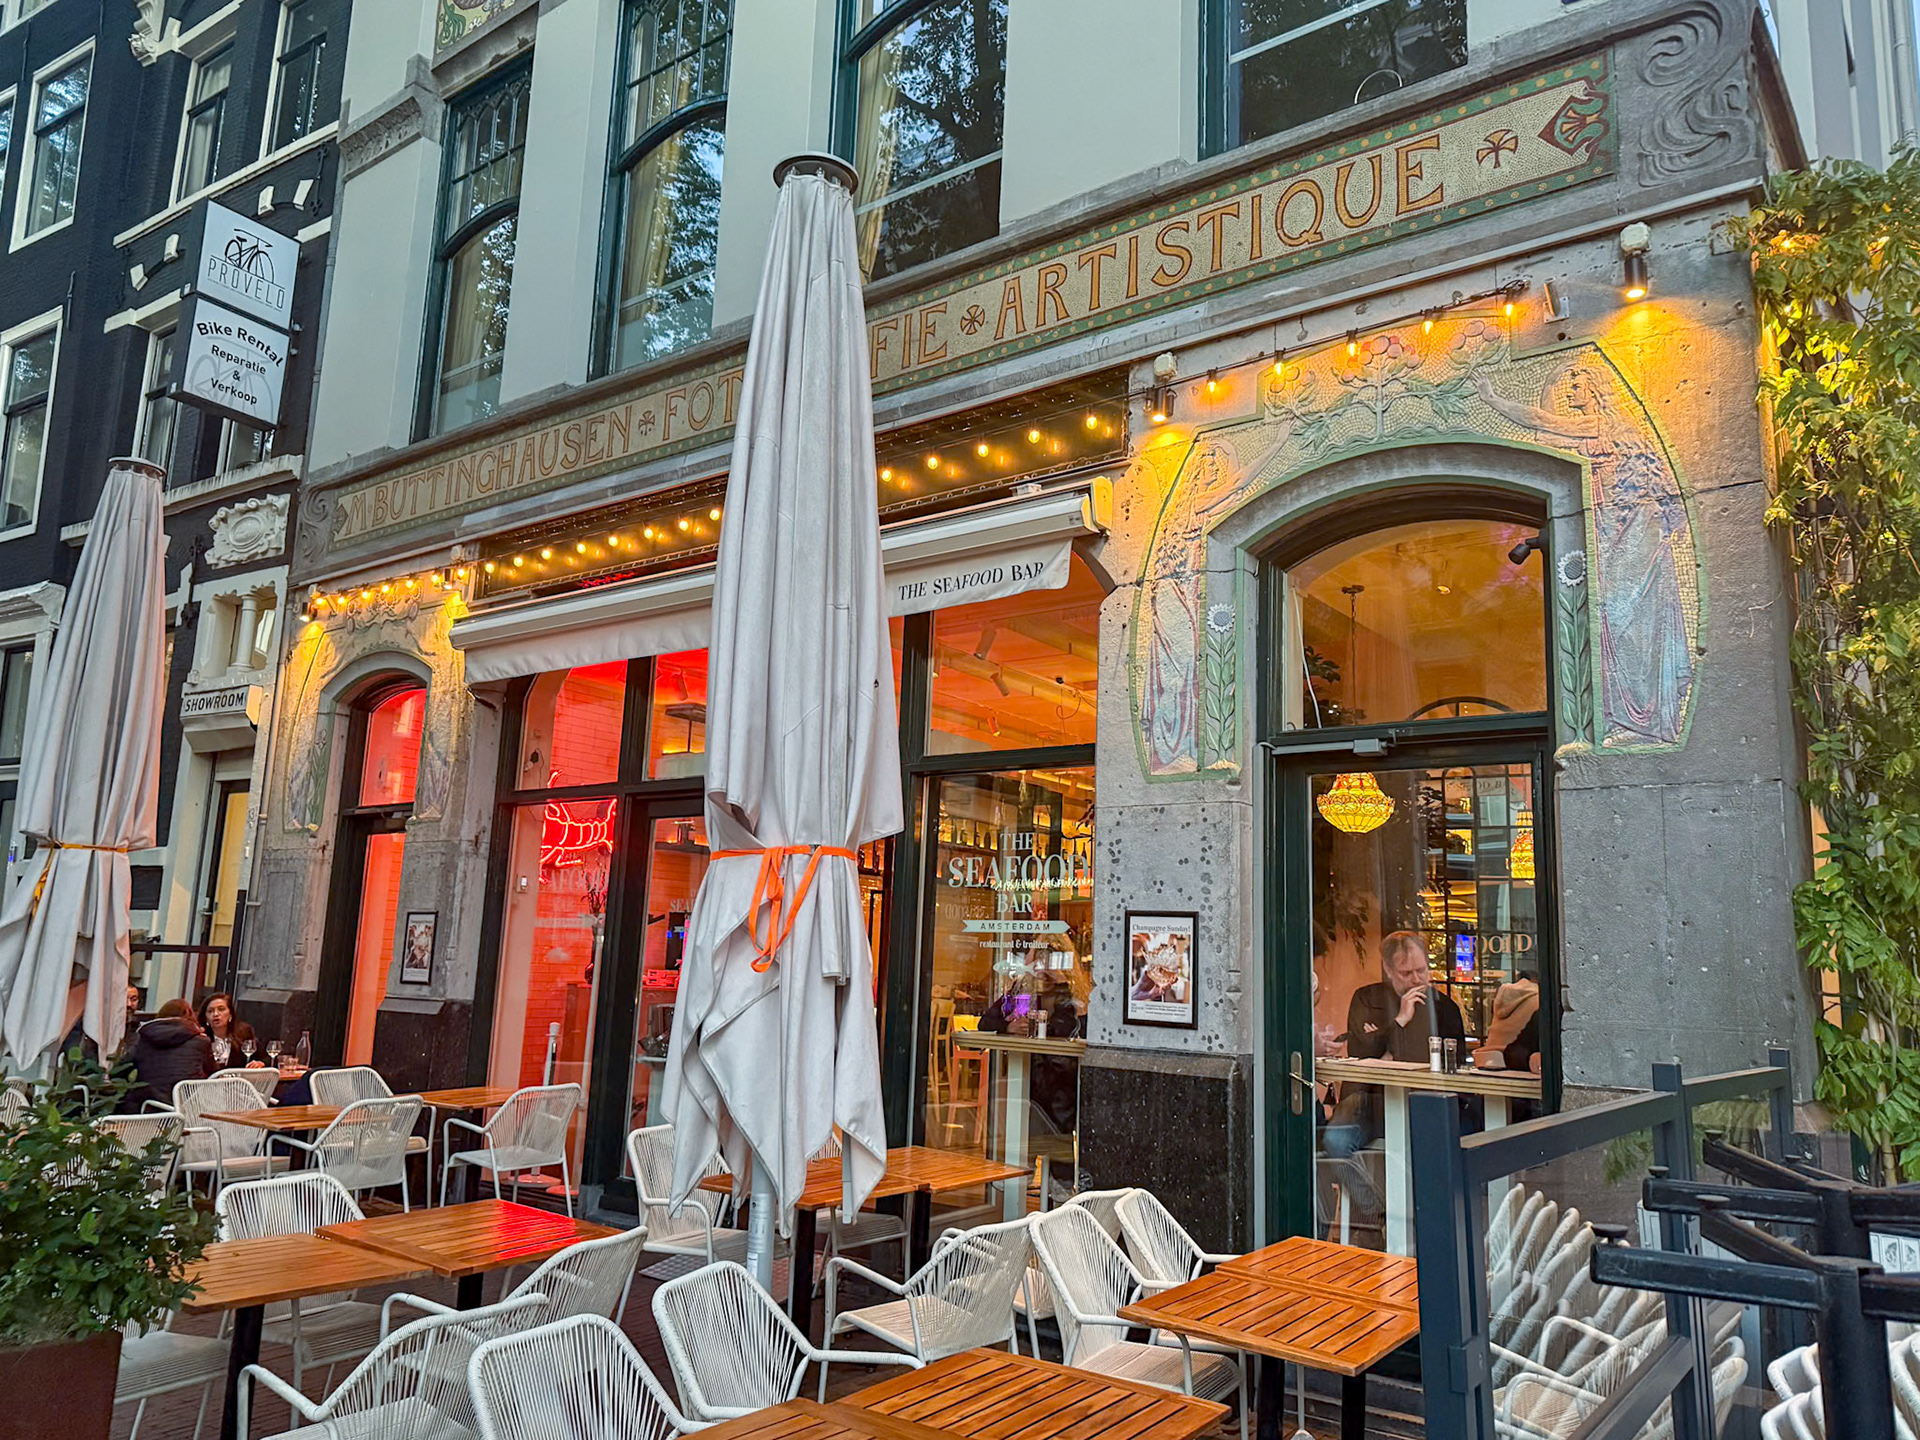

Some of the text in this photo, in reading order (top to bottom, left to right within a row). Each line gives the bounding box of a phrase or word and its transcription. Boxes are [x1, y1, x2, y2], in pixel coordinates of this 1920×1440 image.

[207, 257, 285, 310] PROVELO
[372, 405, 633, 526] BUTTINGHAUSEN
[994, 134, 1445, 341] ARTISTIQUE
[196, 322, 284, 367] Bike Rental
[211, 344, 266, 375] Reparatie
[232, 370, 241, 382] &
[210, 378, 258, 405] Verkoop
[899, 562, 1044, 600] THE SEAFOOD BAR
[185, 692, 245, 712] SHOWROOM
[1000, 832, 1035, 851] THE
[948, 854, 1089, 888] SEAFOOD
[996, 893, 1033, 913] BAR
[980, 922, 1051, 931] AMSTERDAM
[1132, 923, 1167, 932] Champagne
